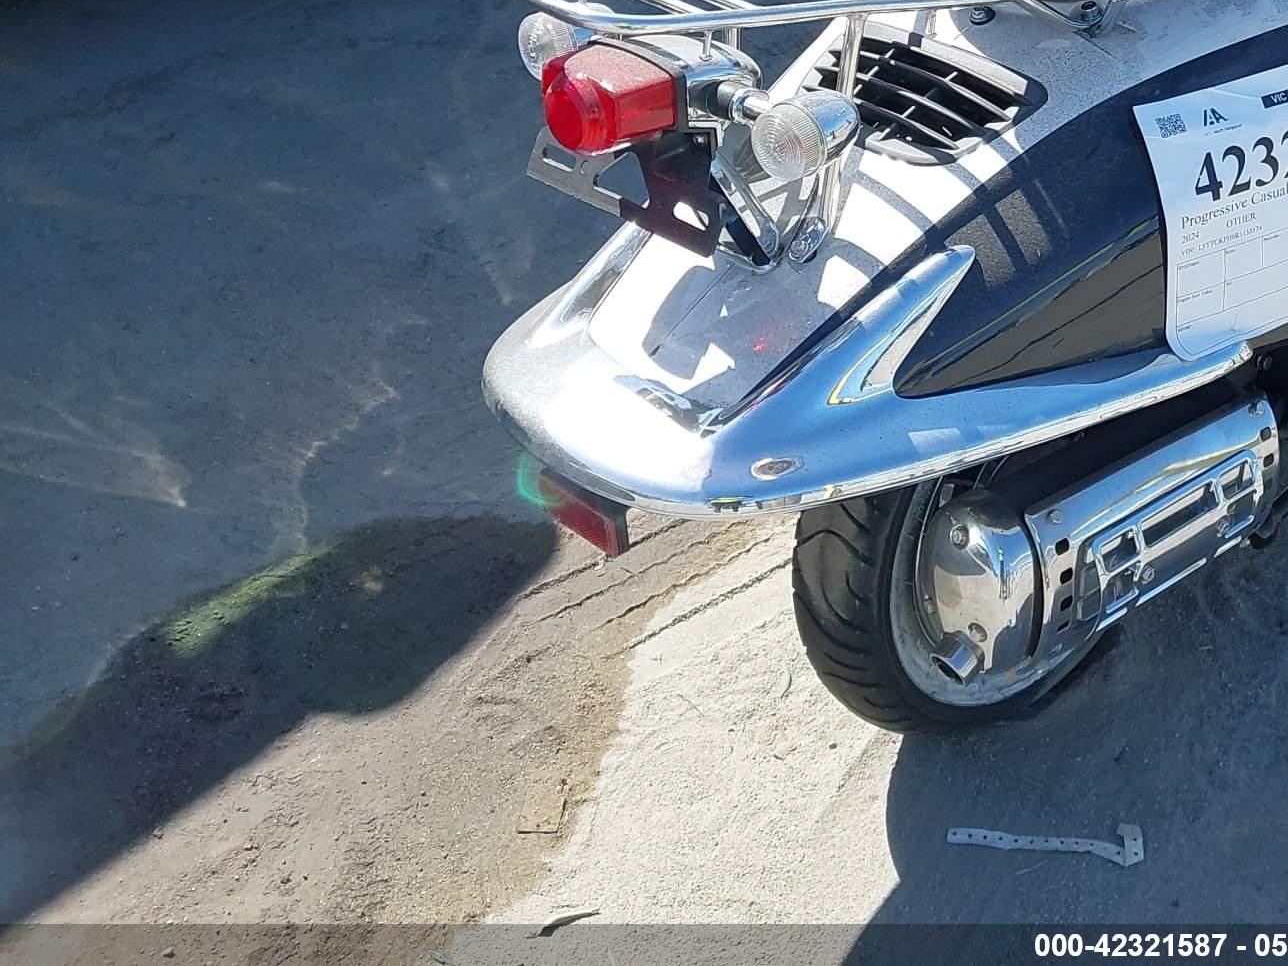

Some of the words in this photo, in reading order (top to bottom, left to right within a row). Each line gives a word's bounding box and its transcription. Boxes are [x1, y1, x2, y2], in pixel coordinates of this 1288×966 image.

[1270, 92, 1288, 104] VIC
[1180, 199, 1248, 229] Progressive
[1181, 231, 1200, 244] 2024
[1225, 212, 1257, 228] OTHER
